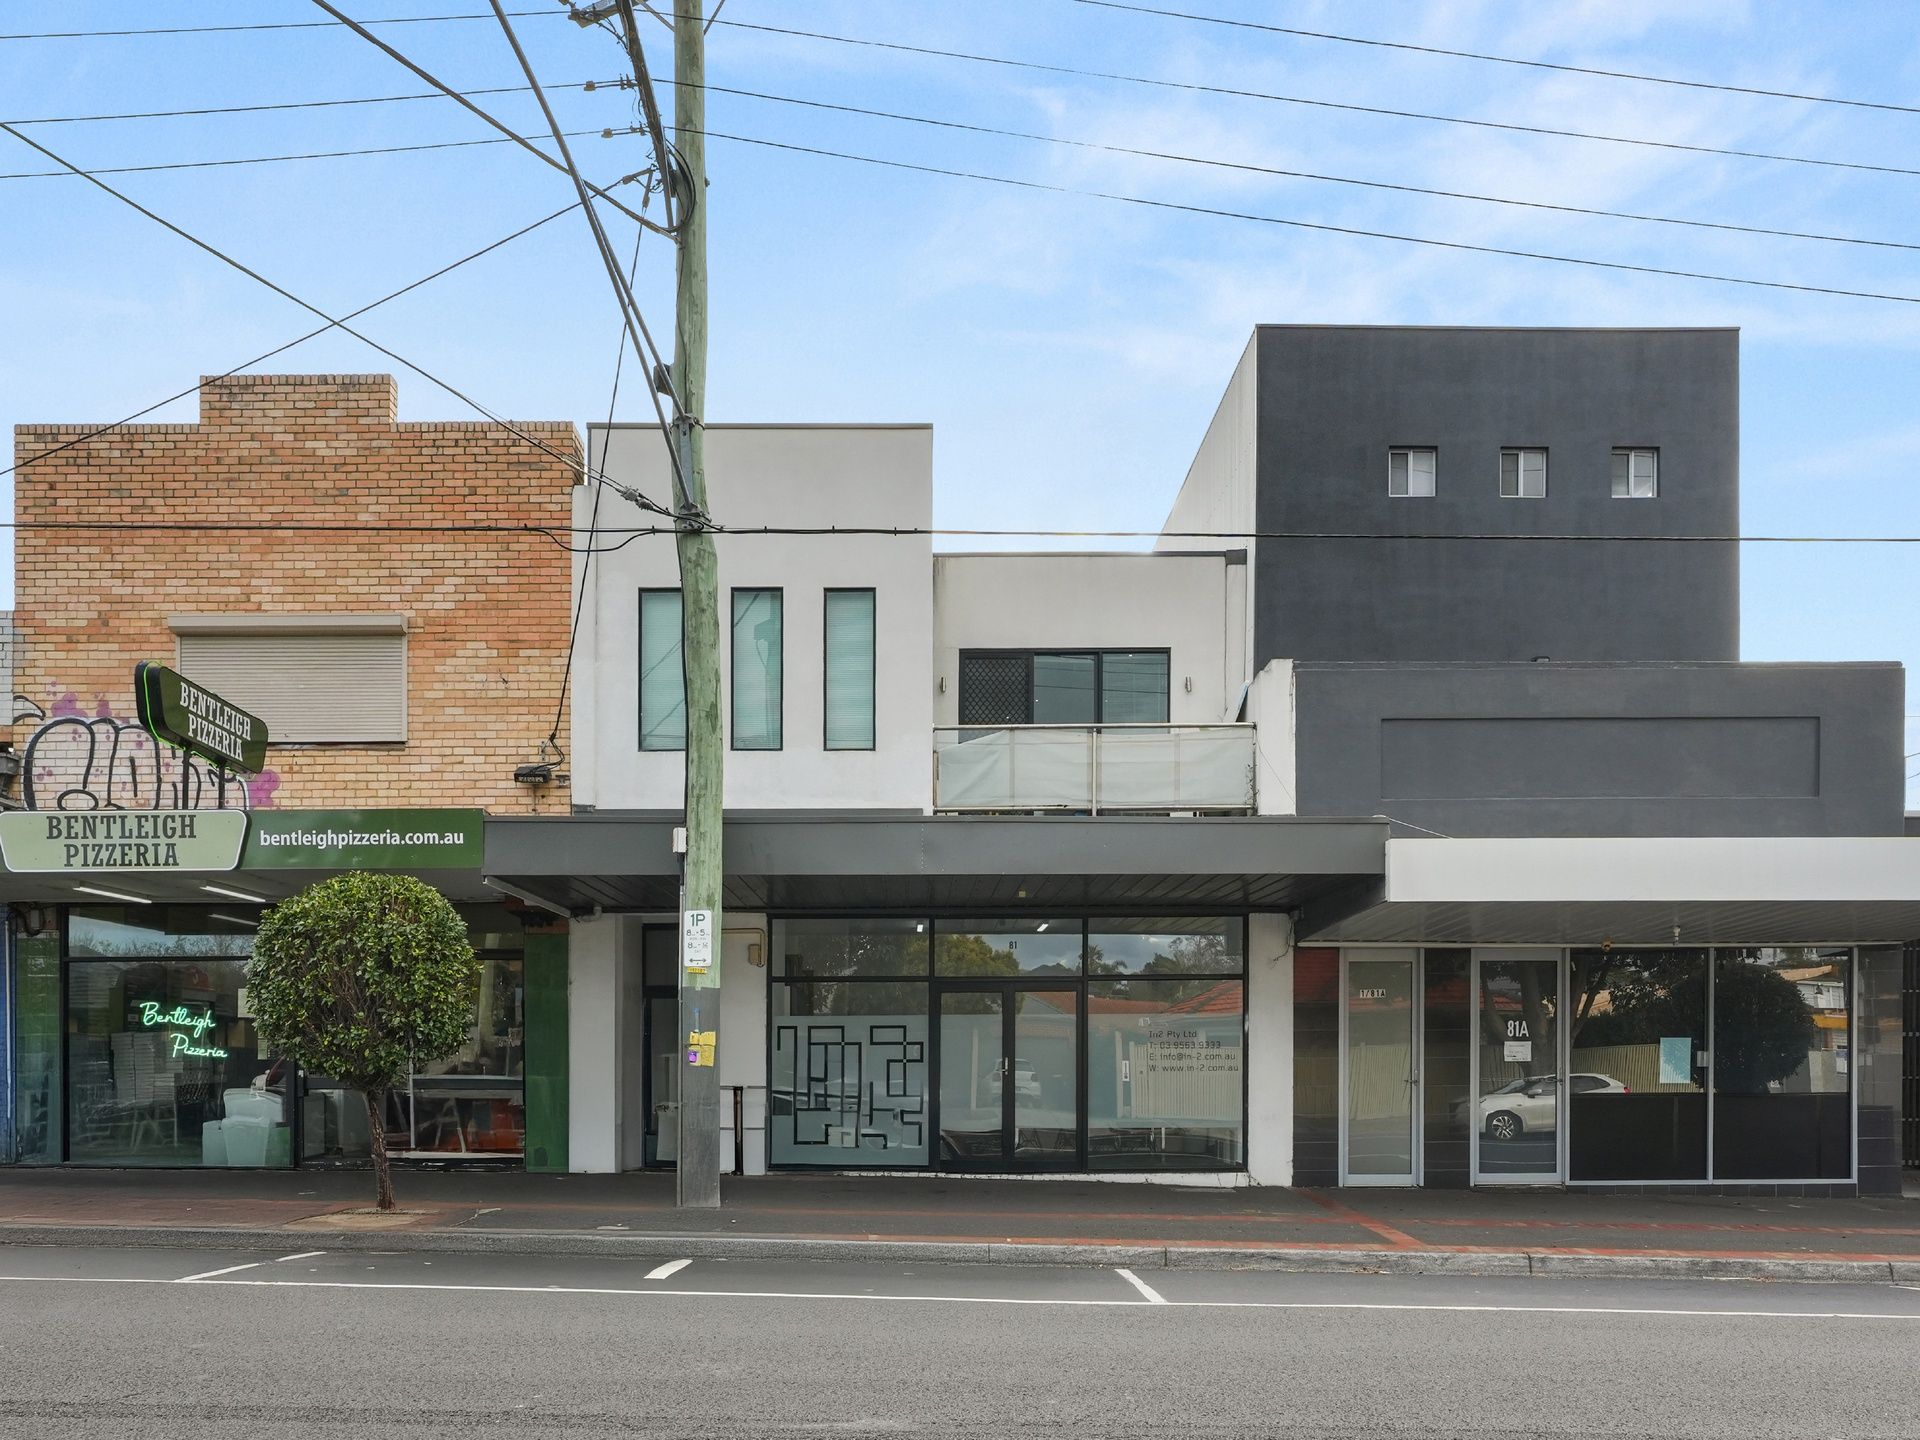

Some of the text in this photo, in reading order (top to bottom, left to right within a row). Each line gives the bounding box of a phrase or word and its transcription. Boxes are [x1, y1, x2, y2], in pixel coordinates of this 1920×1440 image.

[179, 681, 251, 741] BENTLEIGH
[187, 713, 243, 762] PIZZERIA
[46, 815, 197, 840] BENTLEIGH
[260, 829, 464, 849] bentleighpizzeria.com.au
[64, 843, 179, 867] PIZZERIA
[691, 913, 706, 927] 1P
[1009, 941, 1018, 950] 81
[1361, 989, 1385, 998] 1/81A
[139, 1001, 216, 1038] Bentleigh
[1149, 1030, 1197, 1039] In2 Pty Ltd
[1507, 1020, 1529, 1037] 81A
[170, 1033, 228, 1058] Pizzeria
[1160, 1041, 1171, 1049] 03
[1149, 1053, 1157, 1061] E:
[1149, 1064, 1239, 1072] W: www.in-2.com.au
